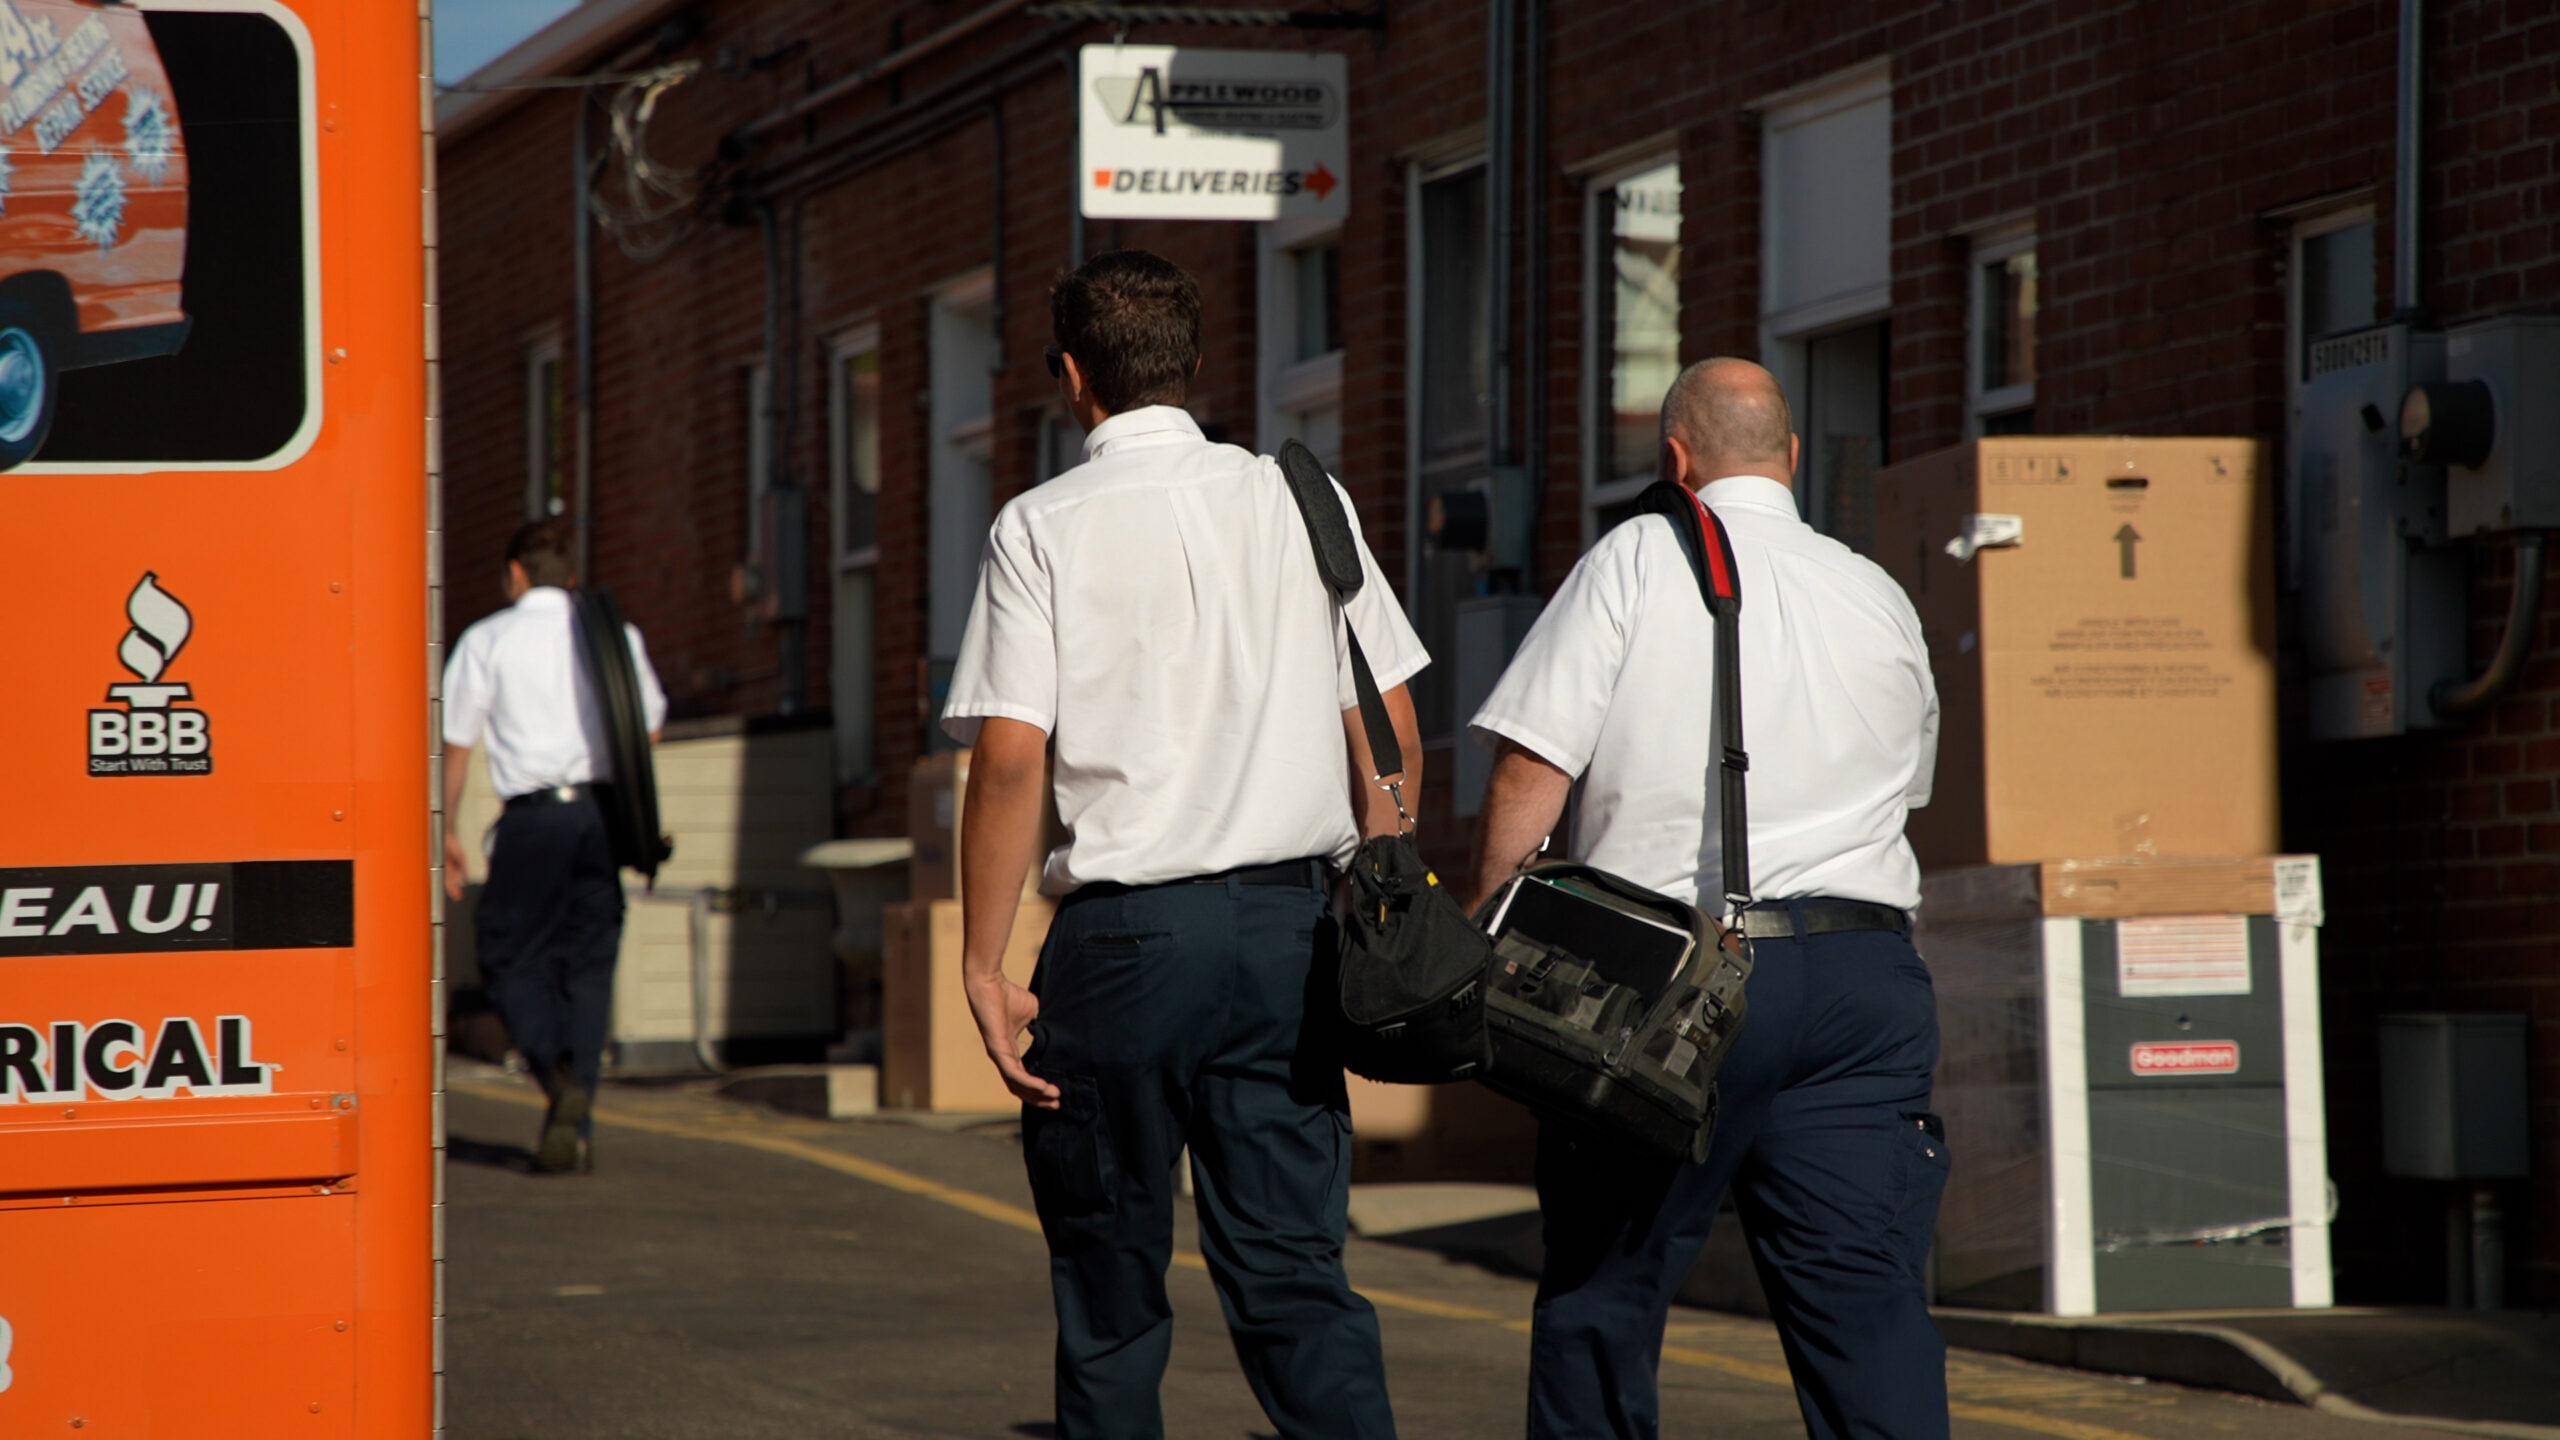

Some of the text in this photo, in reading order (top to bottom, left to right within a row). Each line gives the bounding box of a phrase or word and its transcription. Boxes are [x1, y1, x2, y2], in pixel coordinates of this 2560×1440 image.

[1125, 67, 1324, 134] APPLEWOOD
[1113, 169, 1303, 195] DELIVERIES
[90, 712, 208, 755] BBB
[90, 757, 207, 771] Start With Trust
[0, 883, 220, 937] EAU!
[0, 1015, 272, 1104] RICAL
[2137, 1045, 2233, 1067] Goodman
